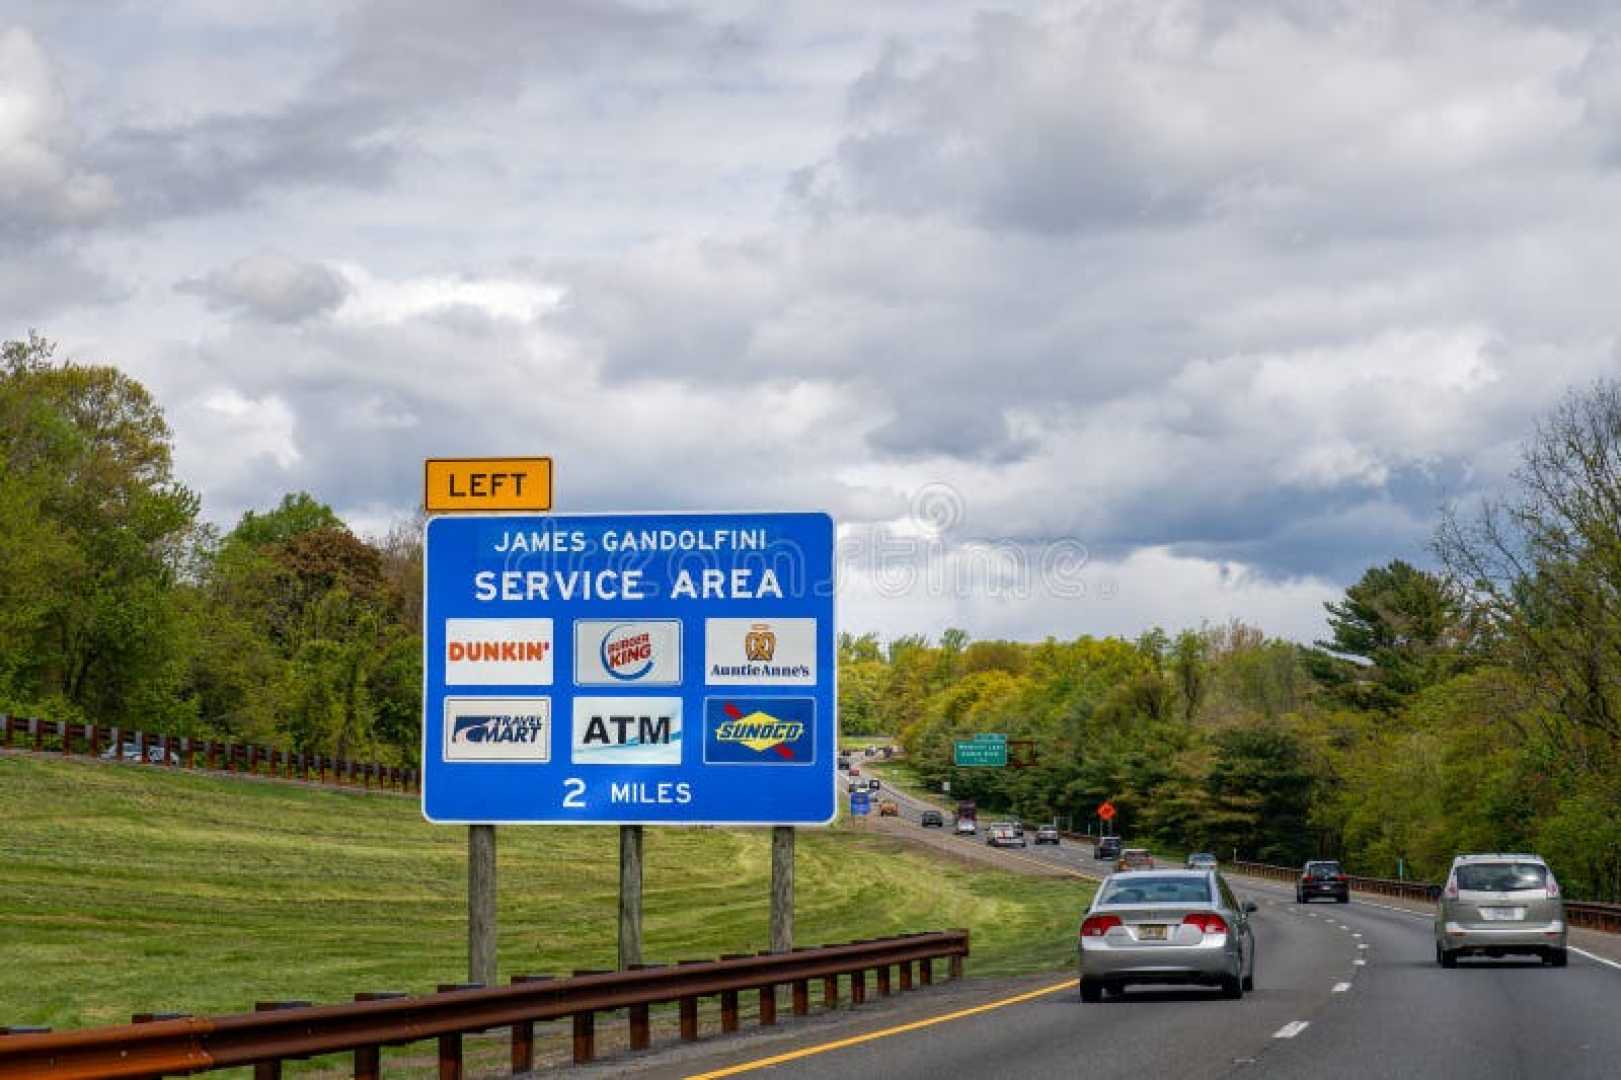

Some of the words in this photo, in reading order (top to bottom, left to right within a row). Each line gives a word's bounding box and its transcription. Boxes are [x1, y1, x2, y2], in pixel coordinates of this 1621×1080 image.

[449, 473, 527, 497] LEFT
[494, 531, 586, 553] JAMES
[602, 528, 767, 551] GANDOLFINI
[475, 570, 644, 600] SERVICE
[670, 568, 783, 599] AREA
[448, 641, 550, 662] DUNKIN'
[610, 644, 652, 668] KING
[485, 726, 541, 743] MART
[489, 715, 542, 730] TRAVEL
[583, 716, 671, 744] ATM
[719, 724, 802, 739] SUNOCO
[562, 778, 587, 808] 2
[611, 782, 692, 804] MILES
